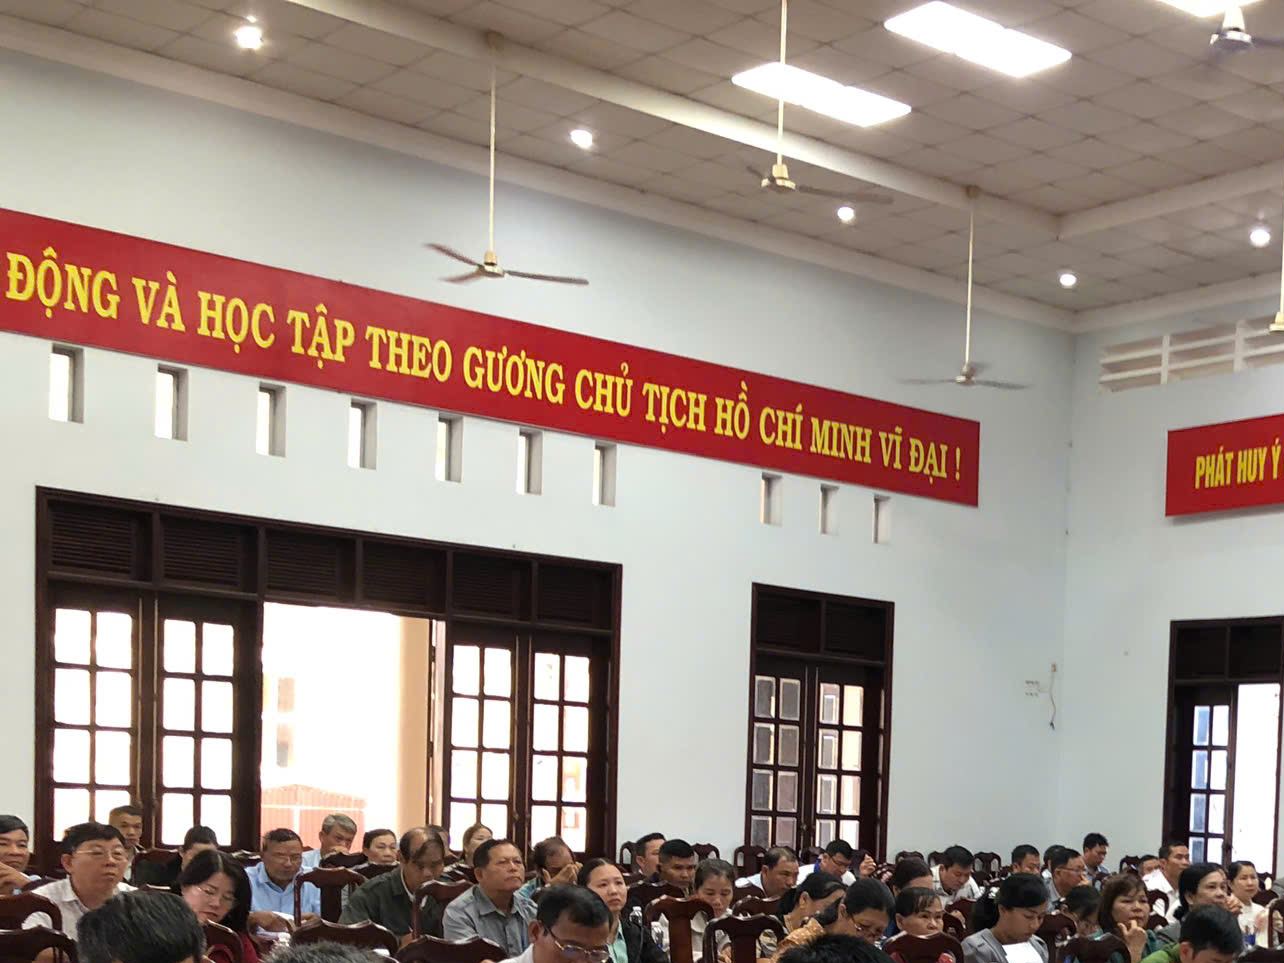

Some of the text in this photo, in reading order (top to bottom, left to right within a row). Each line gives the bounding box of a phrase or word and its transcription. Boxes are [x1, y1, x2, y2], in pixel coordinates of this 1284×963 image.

[5, 246, 121, 319] ĐỘNG
[131, 271, 186, 333] VÀ
[196, 290, 275, 355] HỌC
[286, 303, 355, 369] TẬP
[365, 325, 452, 383] THEO
[463, 345, 565, 405] GƯƠNG
[575, 361, 633, 417] CHỦ
[642, 383, 707, 434] TỊCH
[714, 380, 750, 440] HỒ
[760, 403, 803, 451] CHÍ
[810, 416, 872, 464] MINH
[880, 425, 903, 470] VĨ
[908, 437, 948, 485] ĐẠI
[1194, 442, 1234, 489] PHÁT
[1236, 446, 1268, 484] HUY
[1271, 438, 1282, 480] Ý
